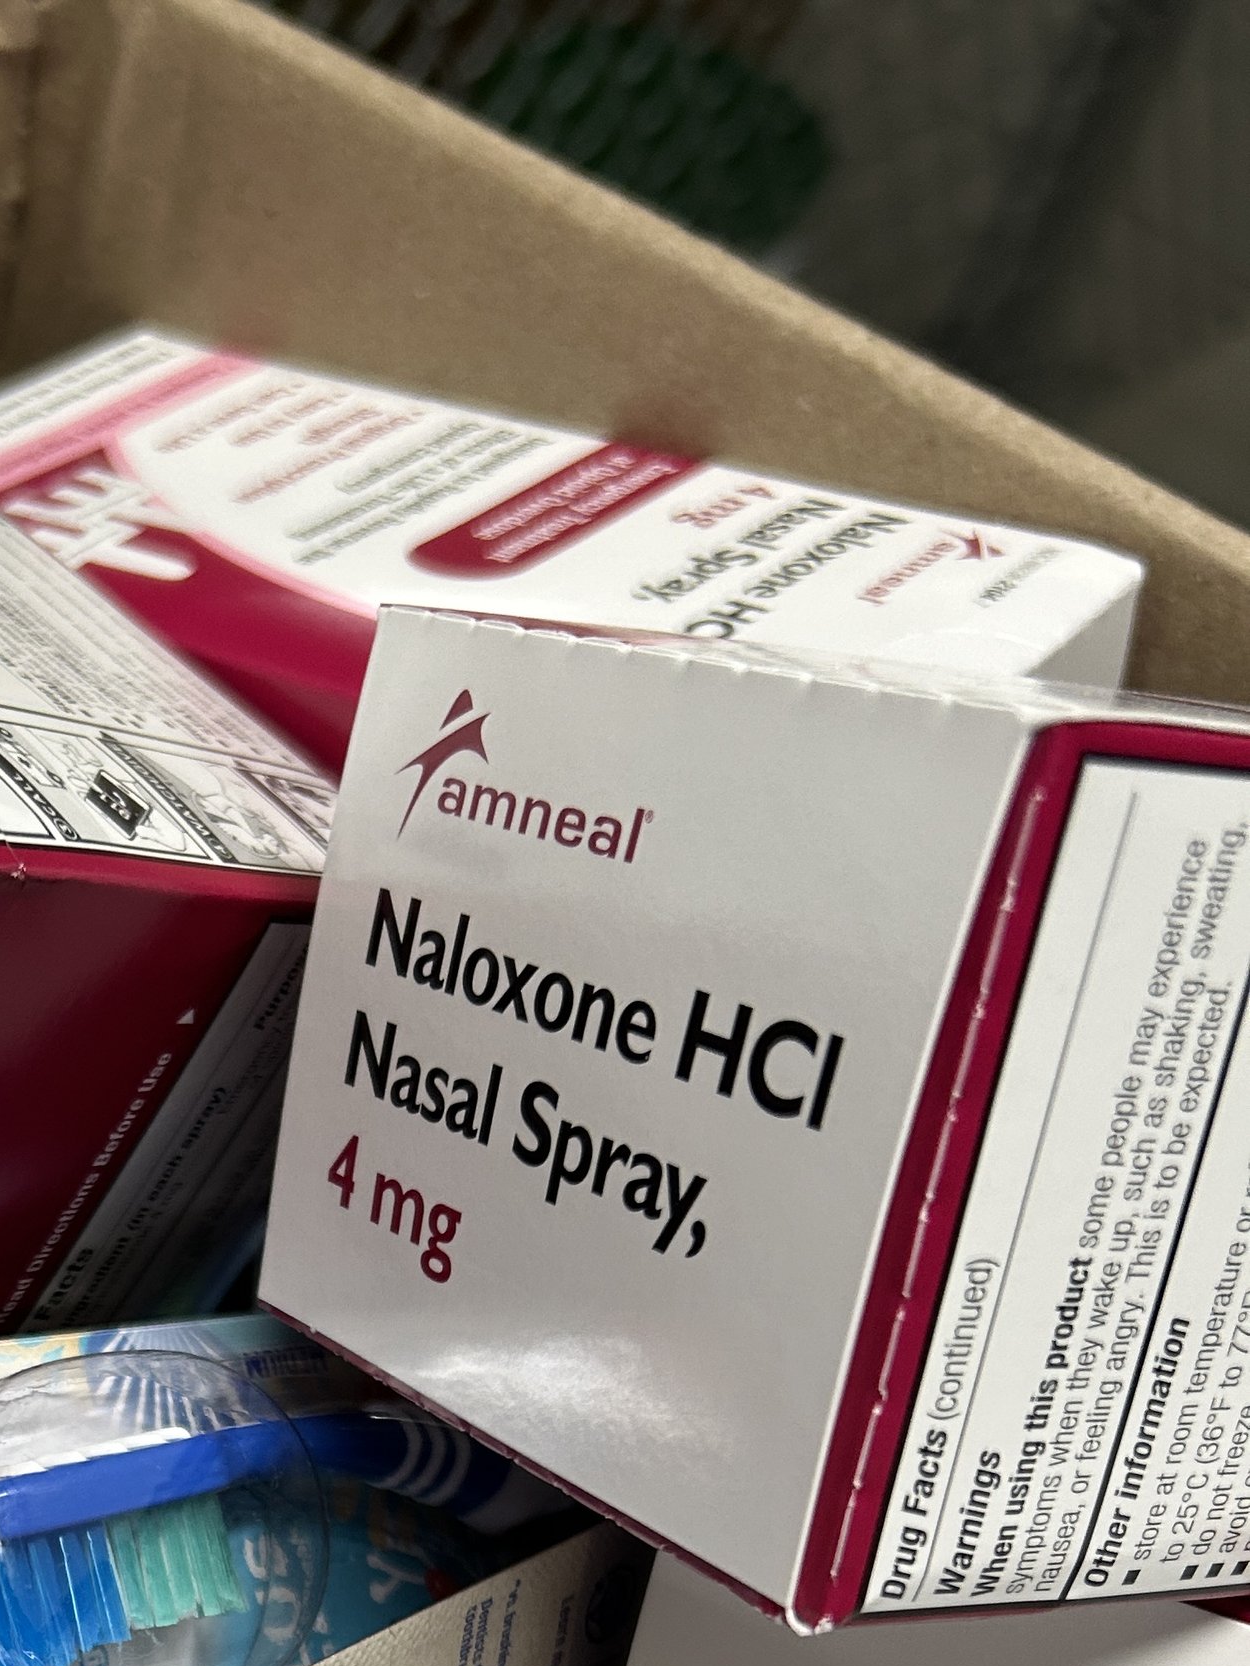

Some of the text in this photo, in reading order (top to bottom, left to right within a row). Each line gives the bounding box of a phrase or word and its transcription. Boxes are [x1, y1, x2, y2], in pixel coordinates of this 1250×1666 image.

[858, 540, 954, 606] amneal
[436, 775, 645, 864] amneal
[365, 887, 844, 1131] Naloxone HCl
[1152, 971, 1207, 1087] shaking,
[344, 1011, 503, 1146] Nasal
[511, 1081, 708, 1259] Spray,
[1122, 1137, 1157, 1201] such
[1142, 1095, 1168, 1128] as
[327, 1136, 463, 1284] 4 mg
[968, 840, 1205, 1597] When using this product some people may experience
[1107, 1211, 1140, 1252] up,
[1032, 981, 1231, 1592] nausea, or feeling angry. This is to be expected.
[1085, 1261, 1122, 1330] wake
[1064, 1337, 1105, 1391] they
[1132, 1241, 1247, 1561] store at room temperature
[879, 1257, 1000, 1600] Drug Facts (continued)
[1047, 1399, 1084, 1466] when
[1083, 1317, 1190, 1587] Other information
[932, 1449, 1001, 1595] Warnings
[1005, 1474, 1062, 1595] symptoms
